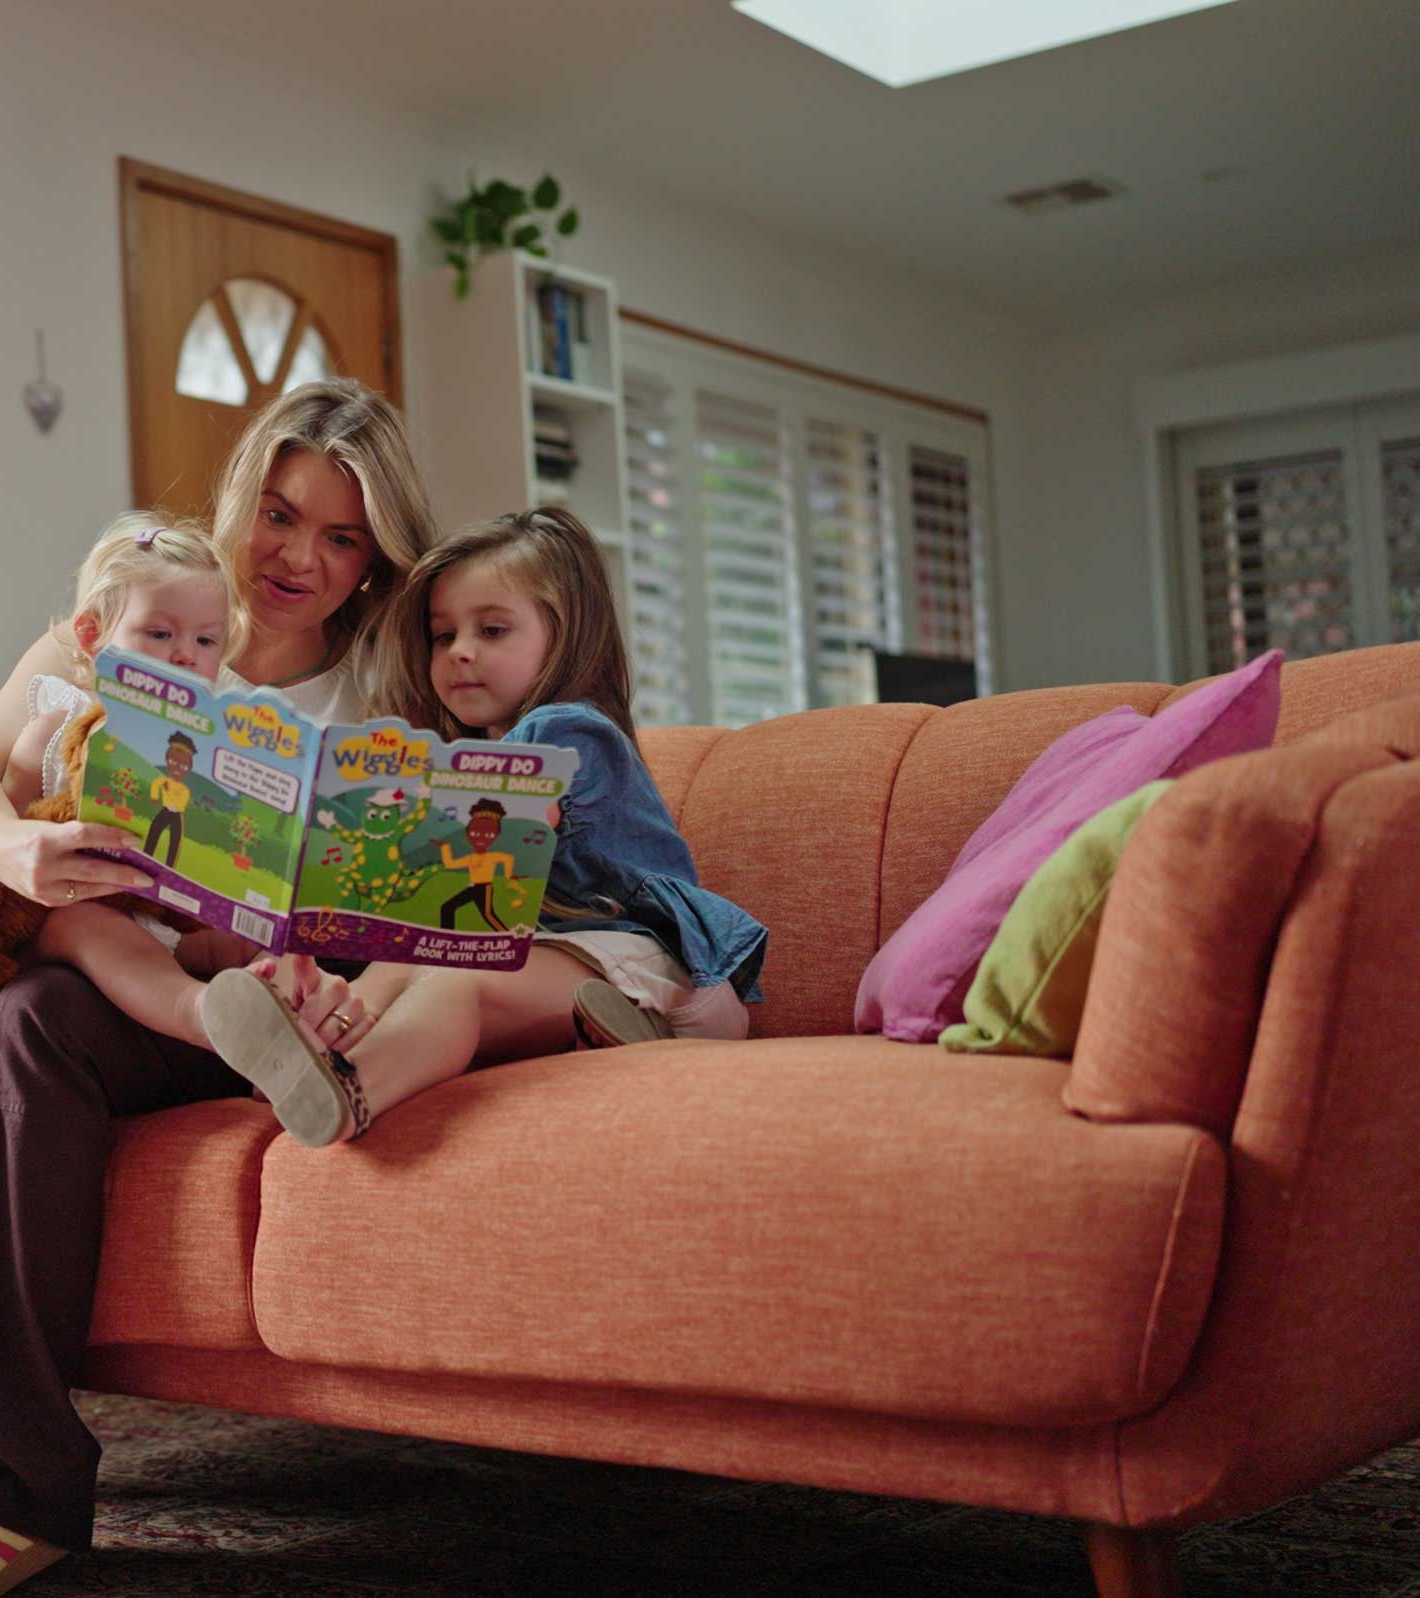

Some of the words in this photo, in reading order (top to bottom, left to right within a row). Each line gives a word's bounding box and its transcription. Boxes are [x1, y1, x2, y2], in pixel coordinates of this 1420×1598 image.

[123, 666, 166, 696] DIPPY
[167, 683, 190, 706] DO
[99, 678, 163, 715] DINOSAUR
[166, 703, 210, 733] DANCE
[253, 705, 274, 725] The
[223, 710, 305, 758] Wiggles
[371, 731, 397, 747] The
[332, 745, 434, 776] Wiggles
[459, 753, 508, 772] DIPPY
[509, 757, 535, 775] DO
[430, 771, 502, 790] DINOSAUR
[506, 777, 556, 794] DANCE
[413, 946, 445, 959] BOOK
[447, 951, 474, 961] WITH
[476, 950, 516, 961] LYRICS!
[418, 936, 427, 946] A
[429, 937, 511, 951] LIFT-THE-FLAP
